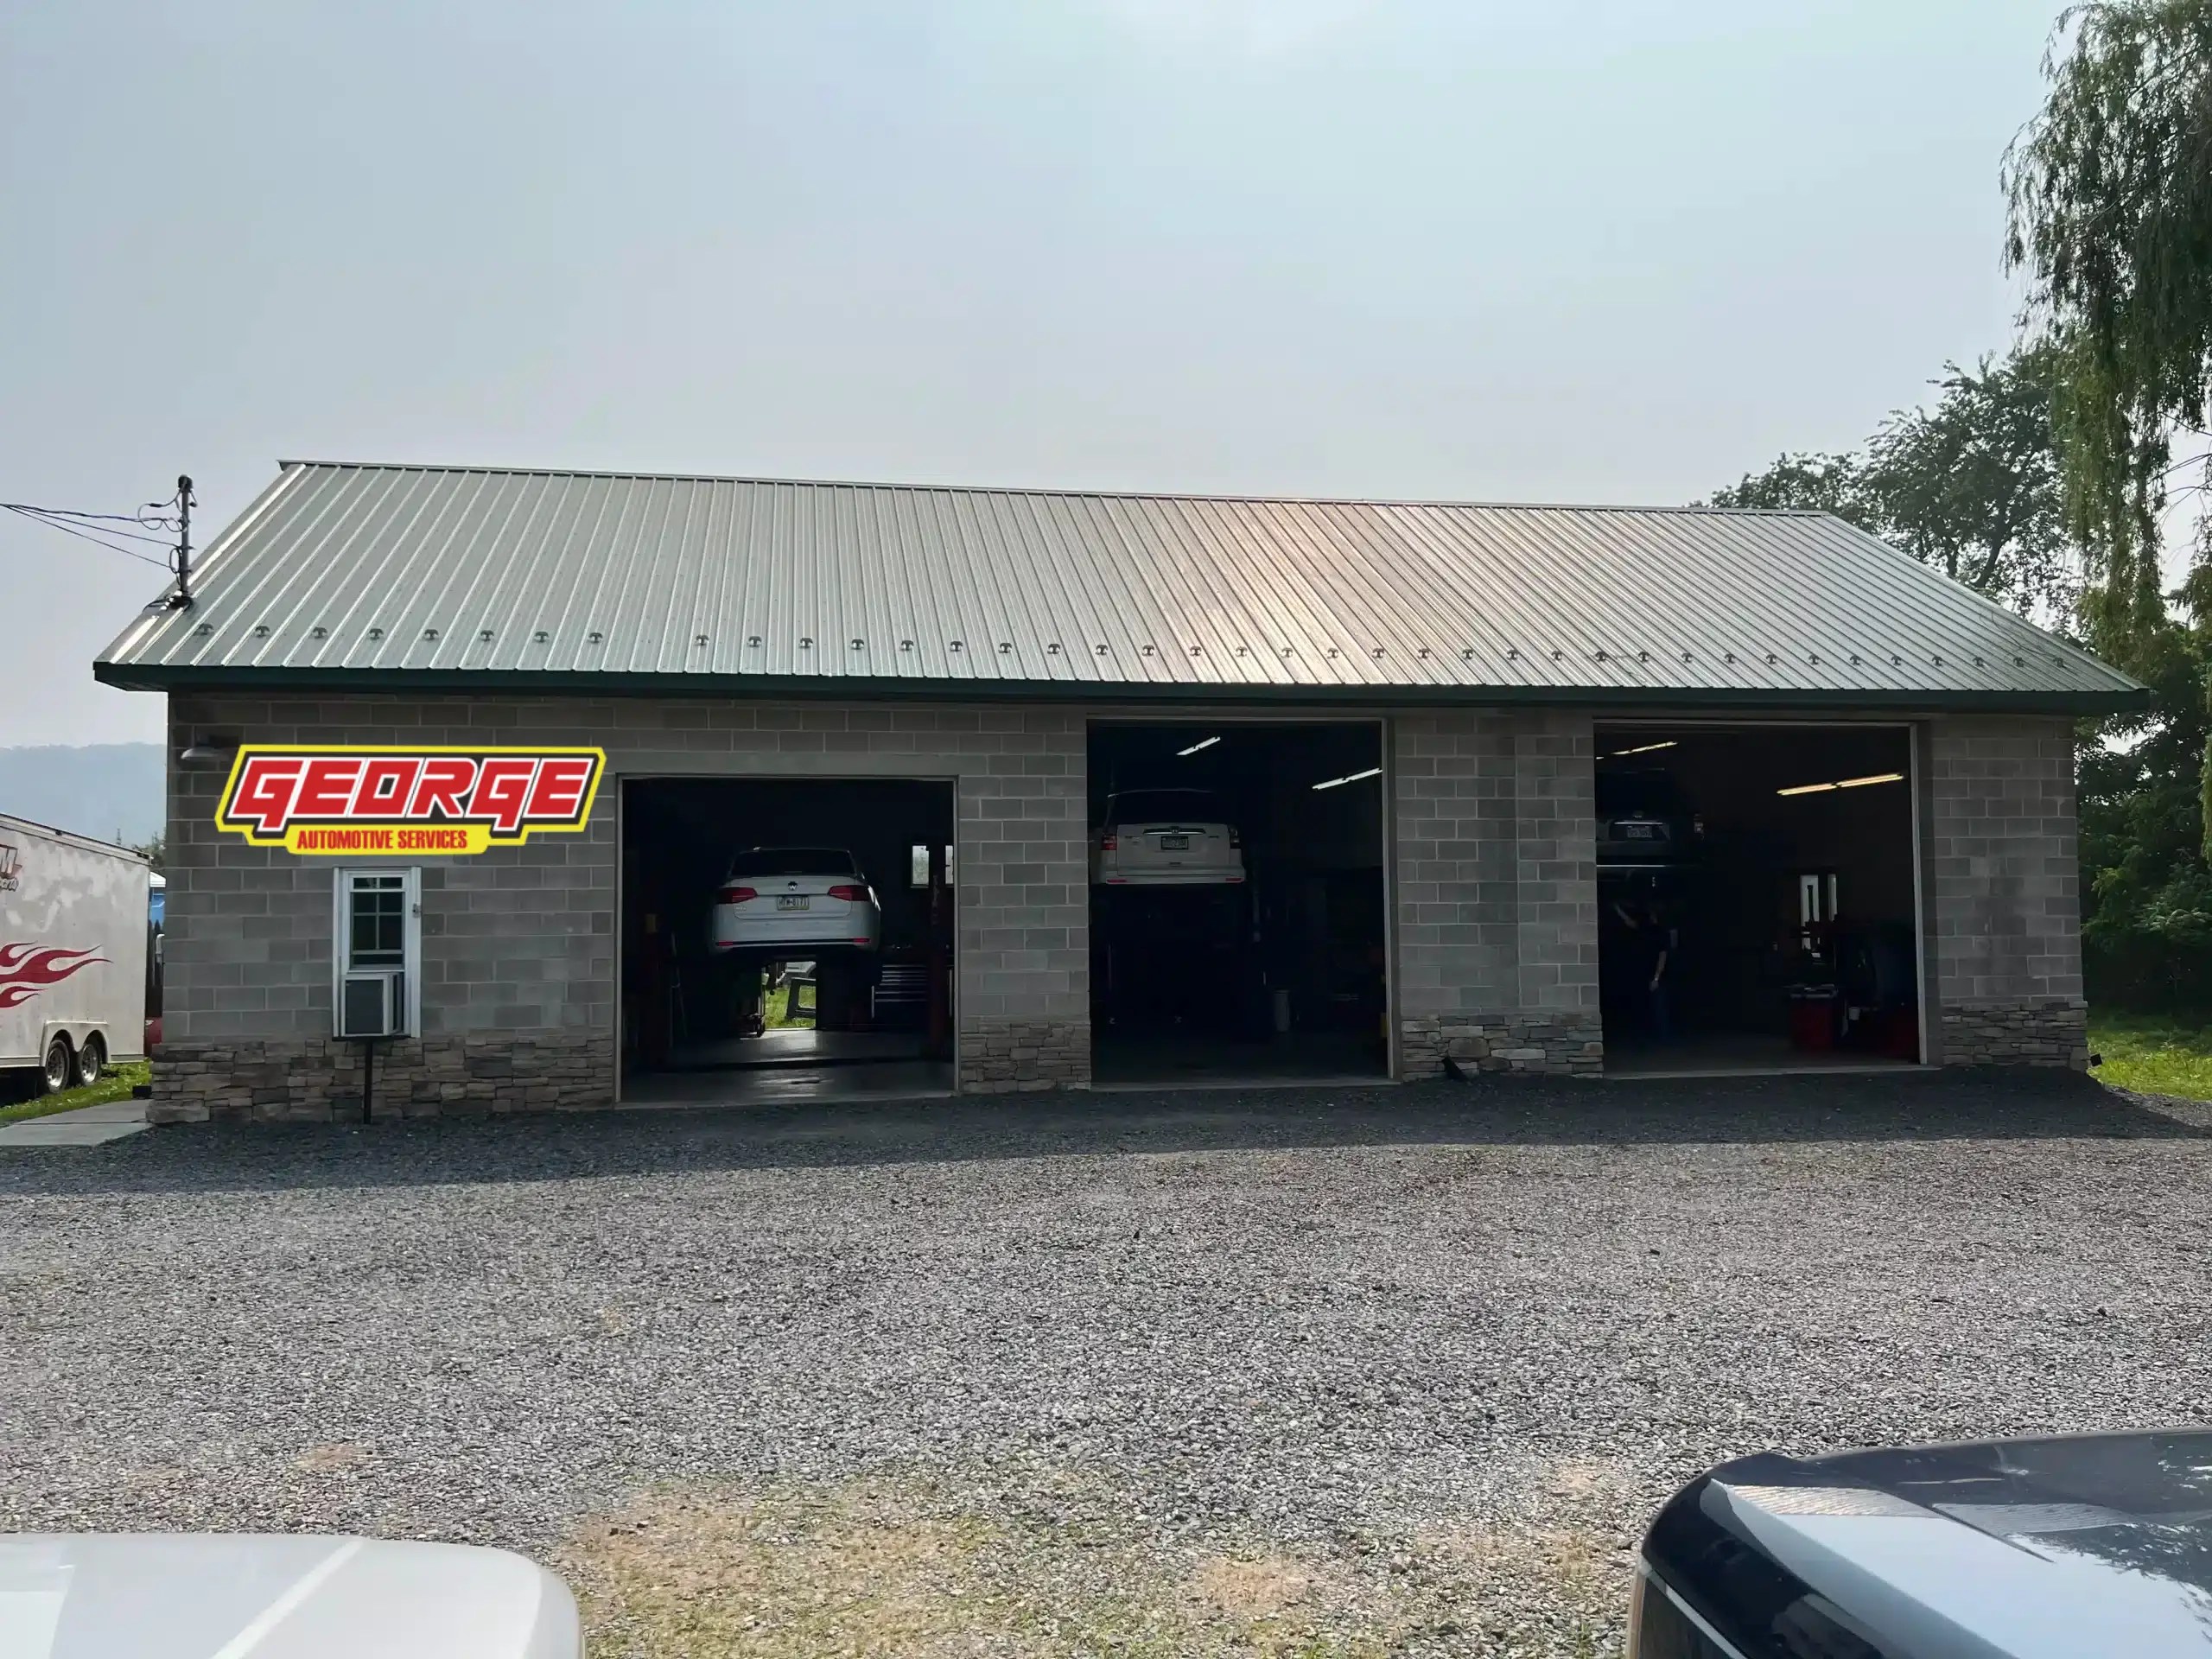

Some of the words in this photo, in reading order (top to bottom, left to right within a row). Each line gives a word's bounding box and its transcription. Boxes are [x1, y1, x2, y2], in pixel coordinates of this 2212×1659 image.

[228, 756, 594, 832] GEORGE
[297, 830, 393, 849] AUTOMOTIVE
[397, 829, 467, 849] SERVICES
